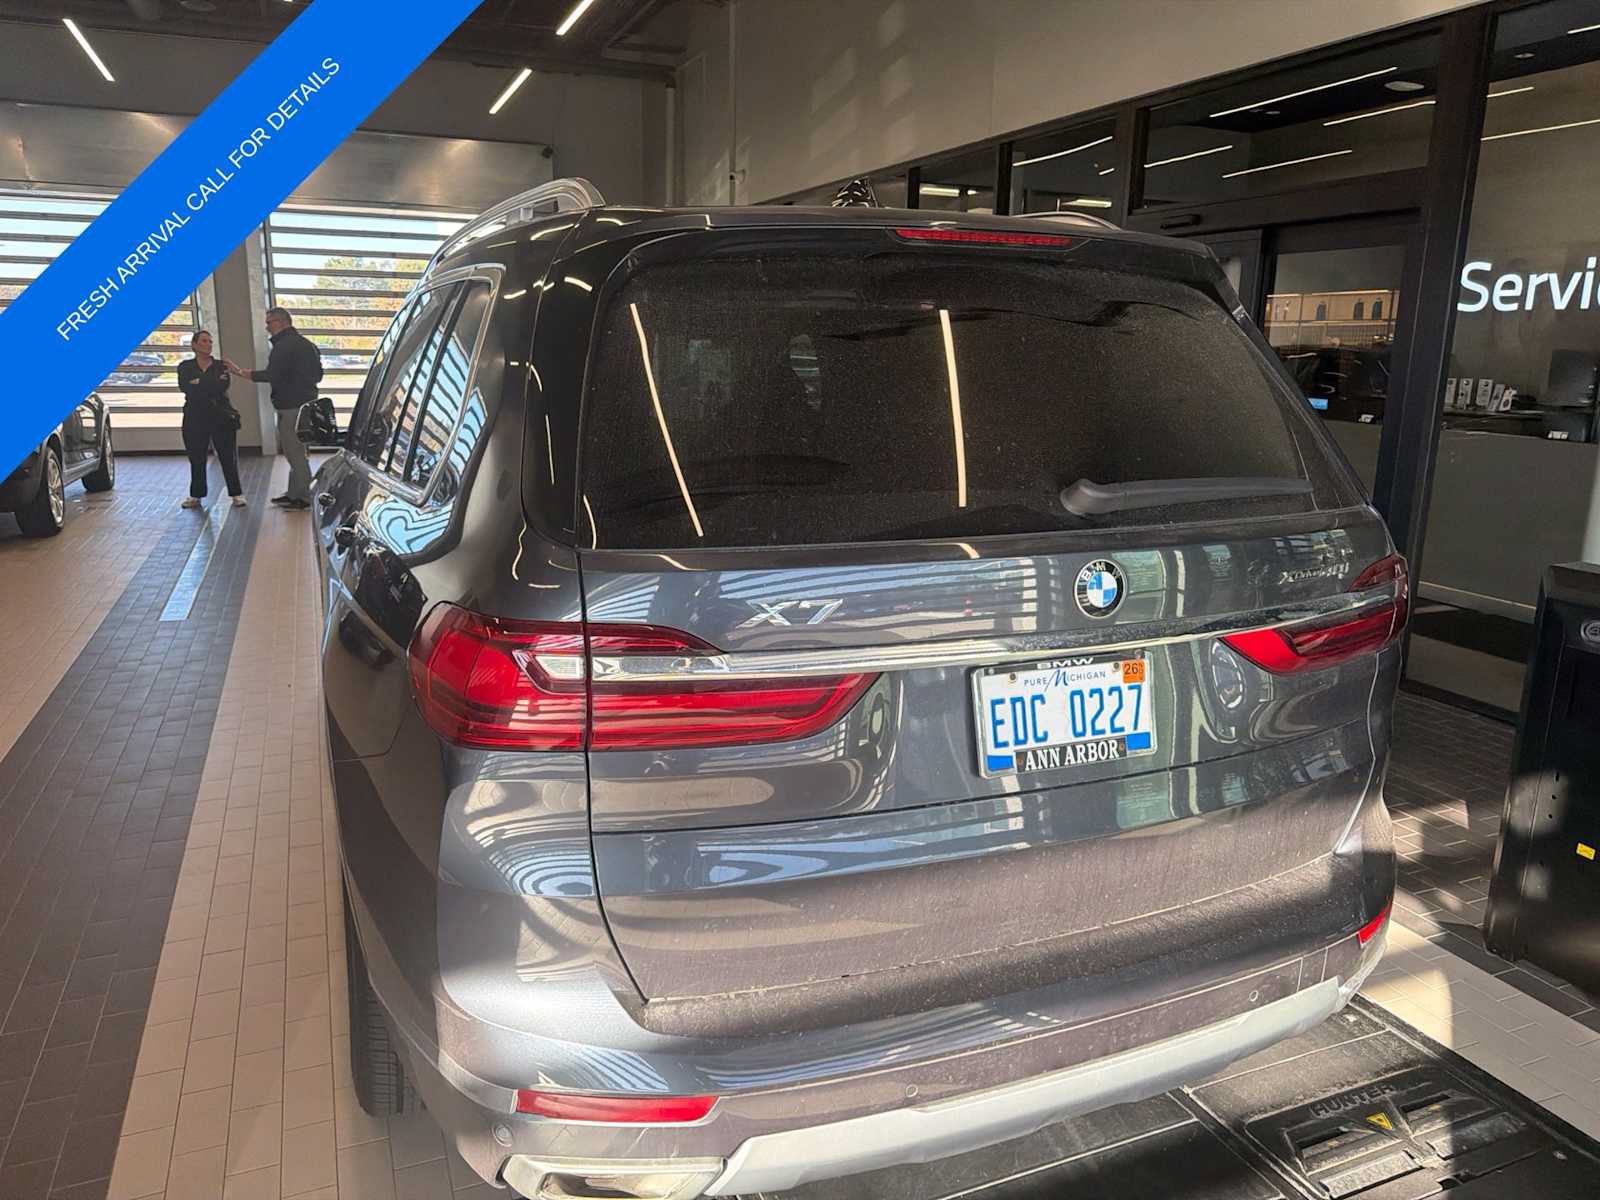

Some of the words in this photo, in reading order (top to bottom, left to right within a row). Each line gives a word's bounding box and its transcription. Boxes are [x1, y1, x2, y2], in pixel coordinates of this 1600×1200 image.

[1456, 256, 1600, 312] Servi
[736, 598, 844, 629] X7
[1036, 657, 1095, 670] BMW
[1124, 662, 1138, 675] 26
[1023, 677, 1048, 687] PURE
[990, 694, 1049, 749] EDC
[1069, 684, 1142, 738] 0227
[1025, 747, 1061, 771] ANN
[1064, 739, 1120, 766] ARBOR
